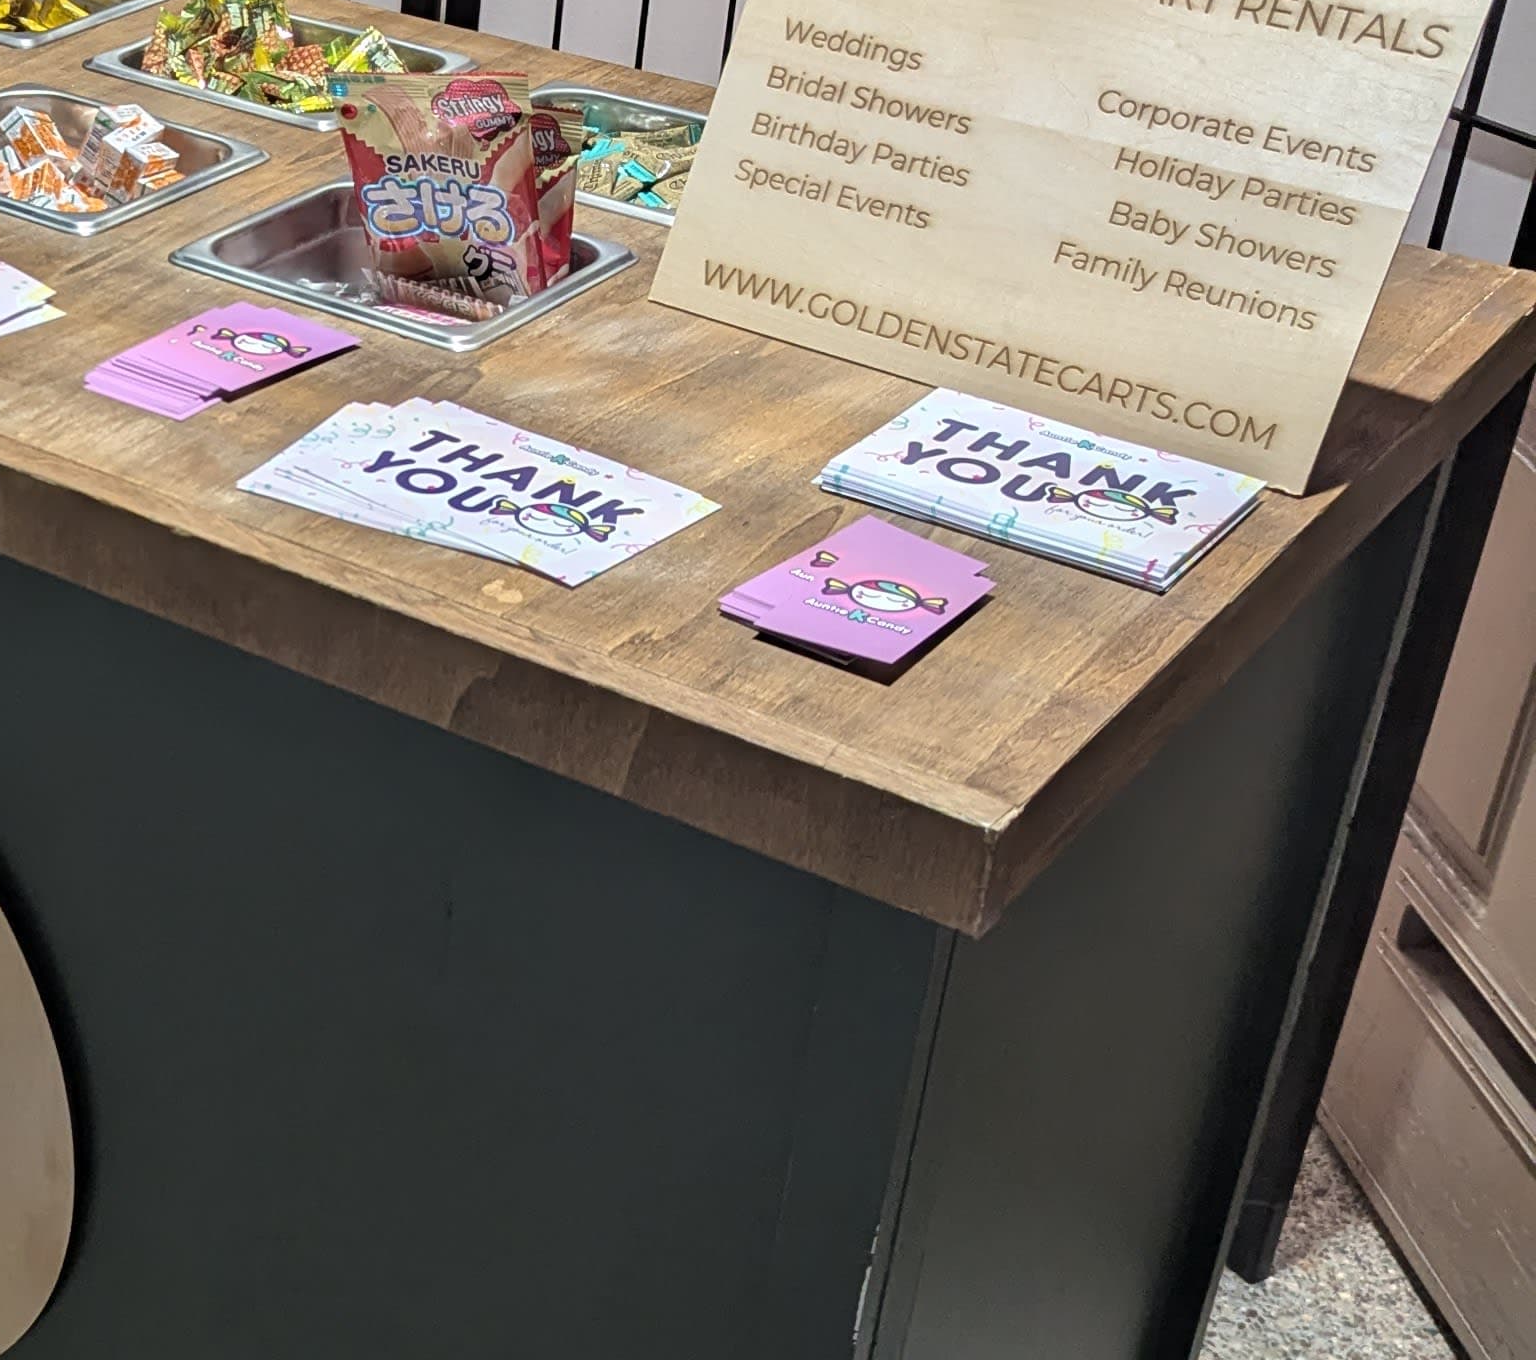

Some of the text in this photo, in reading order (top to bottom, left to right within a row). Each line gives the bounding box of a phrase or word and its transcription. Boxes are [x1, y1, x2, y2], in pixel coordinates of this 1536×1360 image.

[784, 16, 925, 73] Weddings
[436, 94, 505, 120] Stringy
[766, 65, 973, 136] Bridal Showers
[1096, 89, 1378, 174] Corporate Events
[386, 153, 481, 180] SAKERU
[750, 112, 971, 188] Birthday Parties
[362, 176, 515, 246] さける
[734, 158, 832, 204] Special
[836, 185, 931, 230] Events
[1113, 146, 1358, 227] Holiday Parties
[1108, 200, 1338, 280] Baby Showers
[1052, 240, 1318, 332] Family Reunions
[702, 258, 1279, 451] WWW.GOLDENSTATECARTS.COM
[363, 450, 508, 513] YOU
[409, 430, 645, 524] THANK
[900, 440, 1059, 502] YOU
[932, 417, 1197, 507] THANK
[865, 615, 912, 636] Candy
